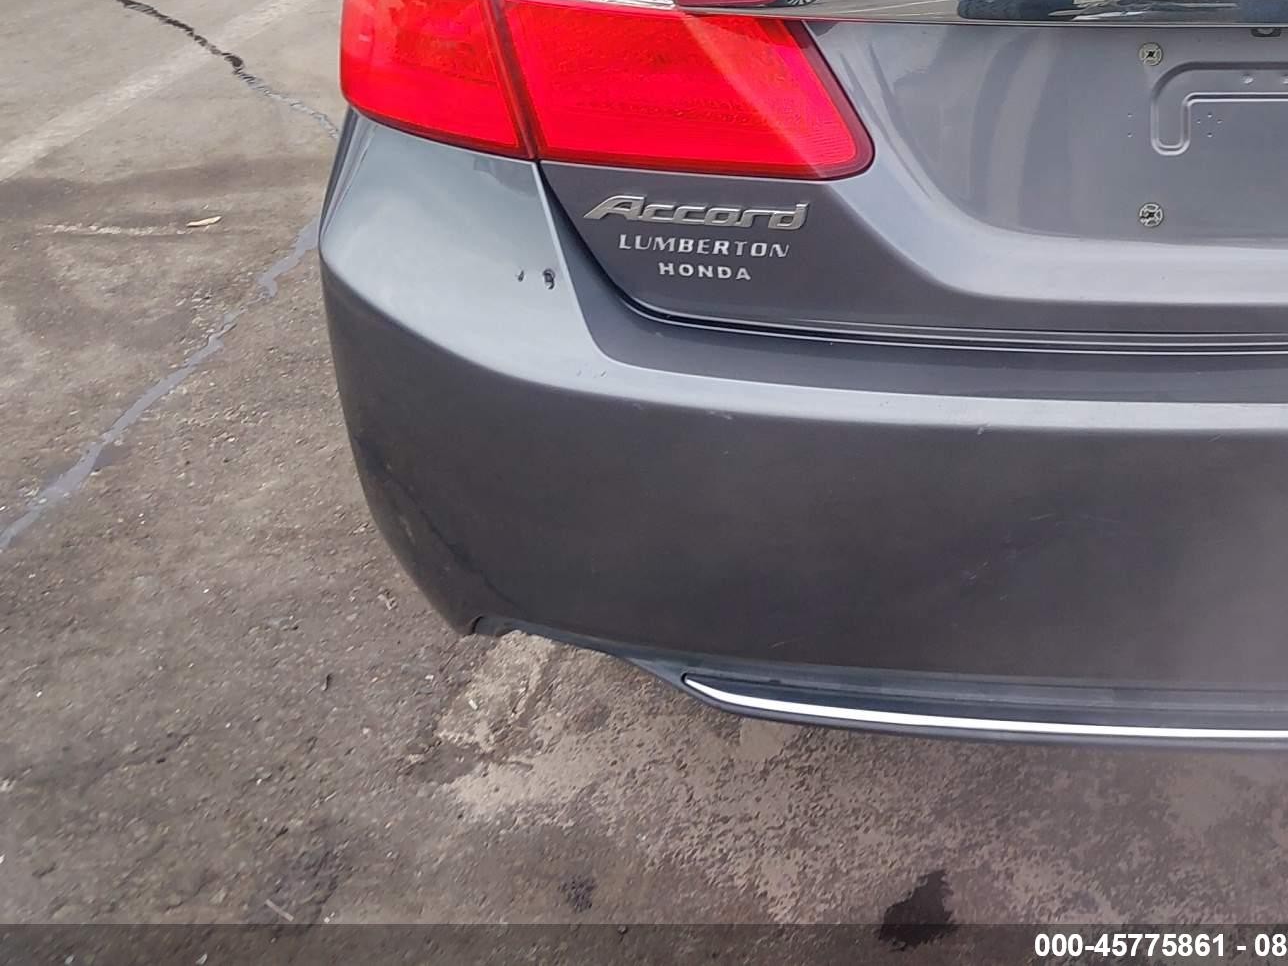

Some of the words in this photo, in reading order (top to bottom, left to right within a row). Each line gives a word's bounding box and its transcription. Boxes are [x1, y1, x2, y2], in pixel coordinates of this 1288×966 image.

[584, 194, 809, 230] Accord
[618, 233, 791, 258] LUMBERTON
[658, 261, 751, 280] HONDA
